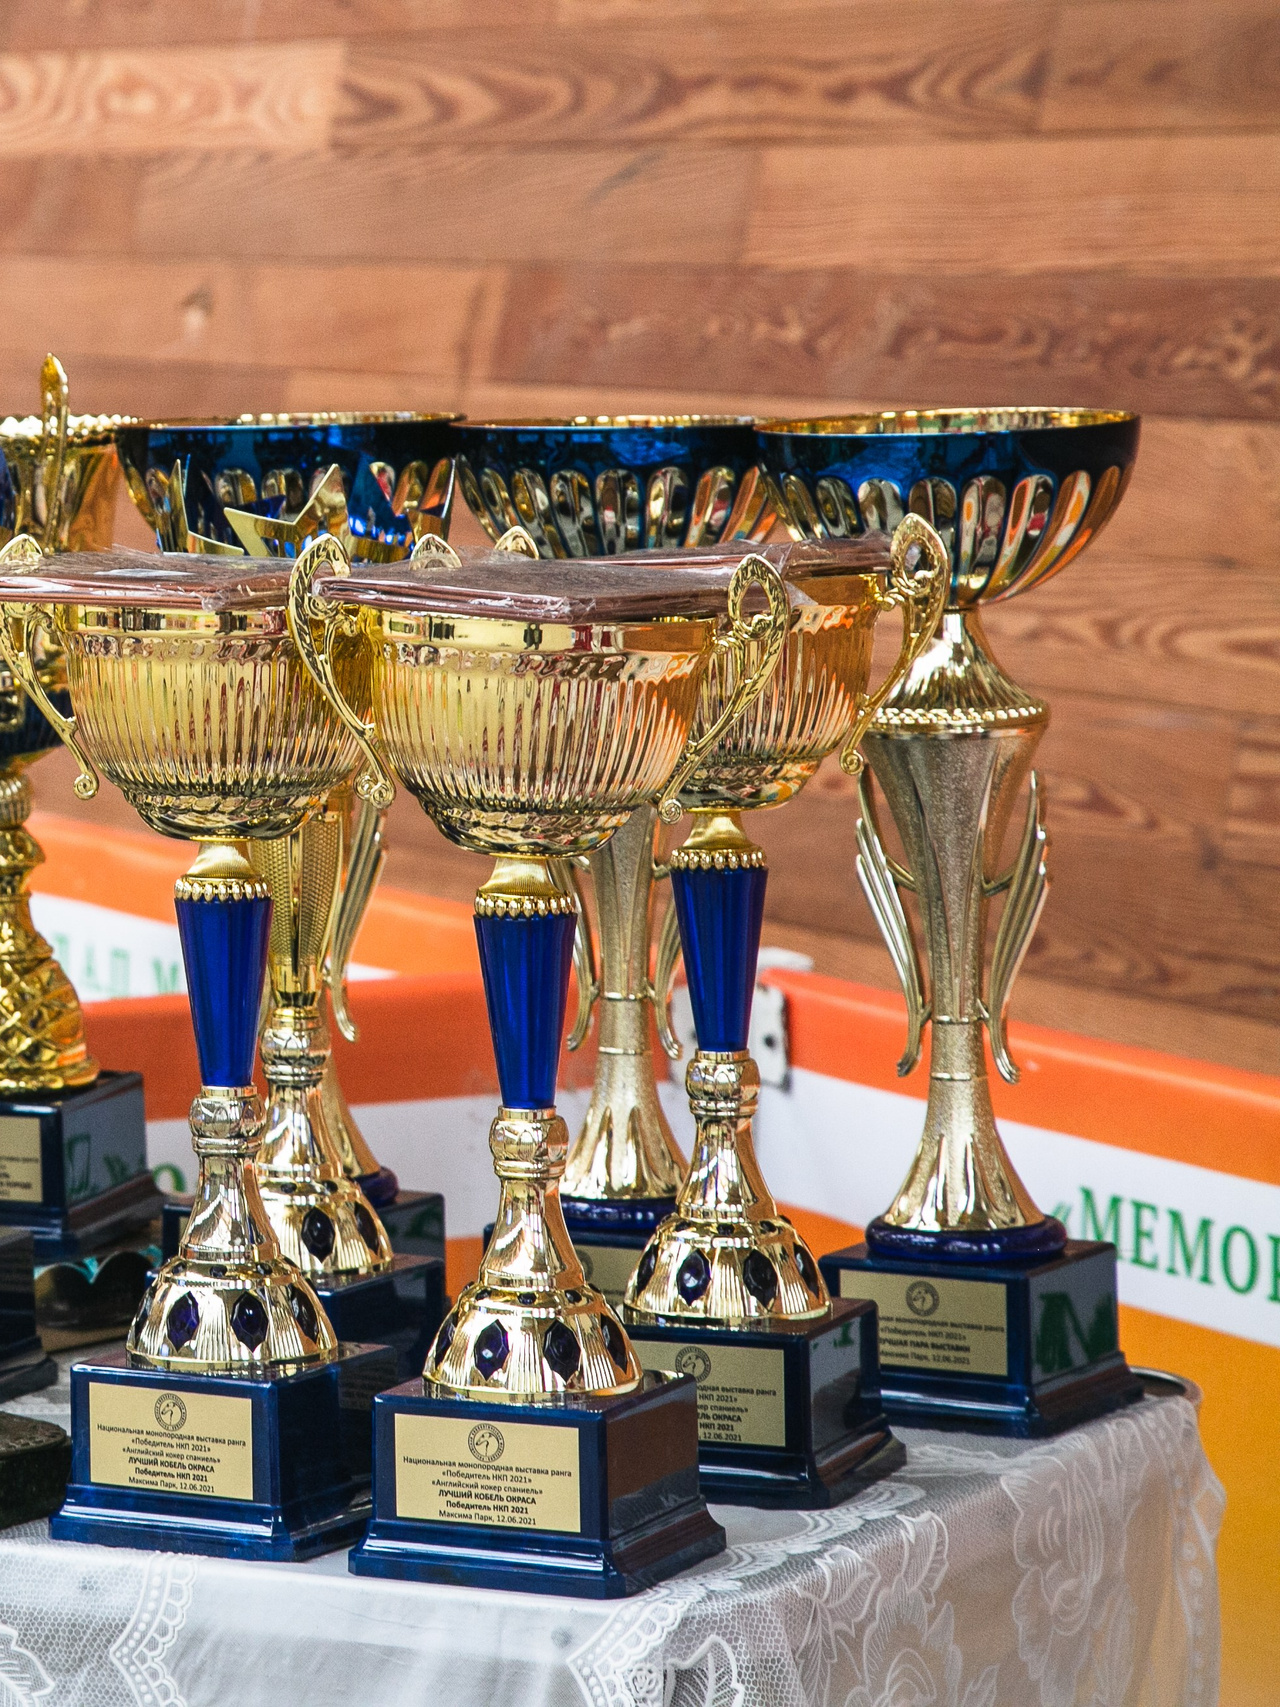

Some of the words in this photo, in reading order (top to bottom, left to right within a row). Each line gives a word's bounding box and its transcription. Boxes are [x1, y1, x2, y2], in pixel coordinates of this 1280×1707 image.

[722, 1386, 754, 1395] выставка
[716, 1395, 737, 1403] 2021»
[710, 1404, 748, 1413] спаниель»
[700, 1422, 715, 1430] НКП
[717, 1423, 734, 1431] 2021
[97, 1423, 144, 1435] Национальная
[146, 1429, 194, 1441] монопородная
[196, 1435, 226, 1444] выставка
[228, 1439, 246, 1447] ранга
[703, 1432, 741, 1441] 12.06.2021
[132, 1438, 174, 1449] «Победитель
[191, 1444, 210, 1452] 2021»
[122, 1447, 164, 1457] «Английский
[166, 1451, 184, 1461] кокер
[186, 1454, 220, 1463] спаниель»
[128, 1456, 158, 1466] ЛУЧШИЙ
[160, 1461, 186, 1470] КОБЕЛЬ
[188, 1464, 214, 1472] ОКРАСА
[403, 1456, 456, 1467] Национальная
[458, 1462, 513, 1472] монопородная
[515, 1466, 548, 1475] выставка
[551, 1469, 571, 1477] ранга
[135, 1468, 175, 1479] Победитель
[176, 1472, 190, 1480] НКП
[192, 1474, 208, 1482] 2021
[442, 1470, 490, 1481] «Победитель
[492, 1474, 508, 1482] НКП
[129, 1477, 158, 1486] Максима
[160, 1480, 177, 1489] Парк,
[180, 1482, 214, 1492] 12.06.2021
[432, 1479, 478, 1489] «Английский
[480, 1484, 501, 1493] кокер
[504, 1486, 543, 1495] спаниель»
[438, 1489, 472, 1499] ЛУЧШИЙ
[475, 1493, 504, 1502] КОБЕЛЬ
[506, 1496, 536, 1505] ОКРАСА
[446, 1500, 491, 1512] Победитель
[493, 1504, 509, 1512] НКП
[511, 1506, 528, 1514] 2021
[439, 1510, 472, 1520] Максима
[475, 1513, 494, 1523] Парк,
[497, 1515, 536, 1525] 12.06.2021
